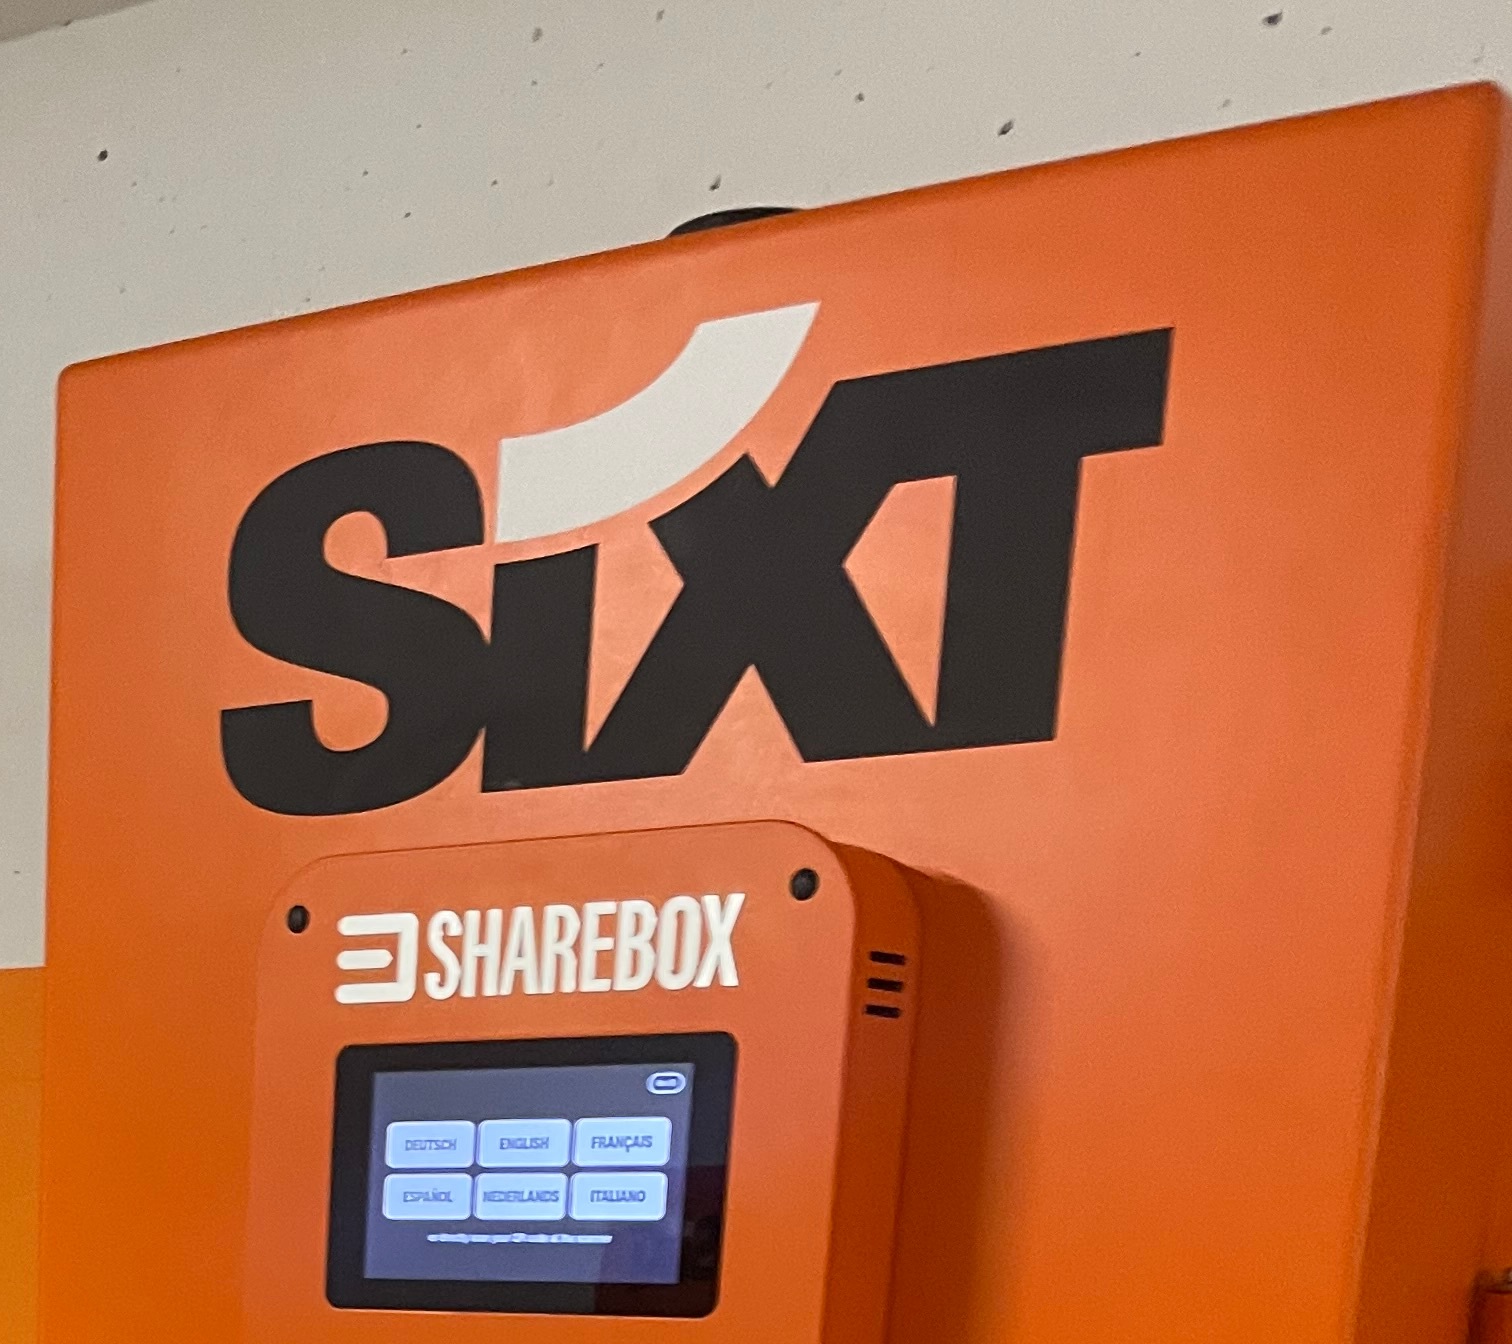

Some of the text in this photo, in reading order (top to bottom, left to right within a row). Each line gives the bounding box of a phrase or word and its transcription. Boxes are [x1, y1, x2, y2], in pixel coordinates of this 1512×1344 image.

[220, 302, 1174, 816] SIXT
[424, 893, 746, 1000] SHAREBOX
[404, 1138, 457, 1151] DEUTSCH
[499, 1137, 549, 1150] ENGLISH
[591, 1135, 653, 1152] FRANÇAIS
[590, 1189, 647, 1203] ITALIANO
